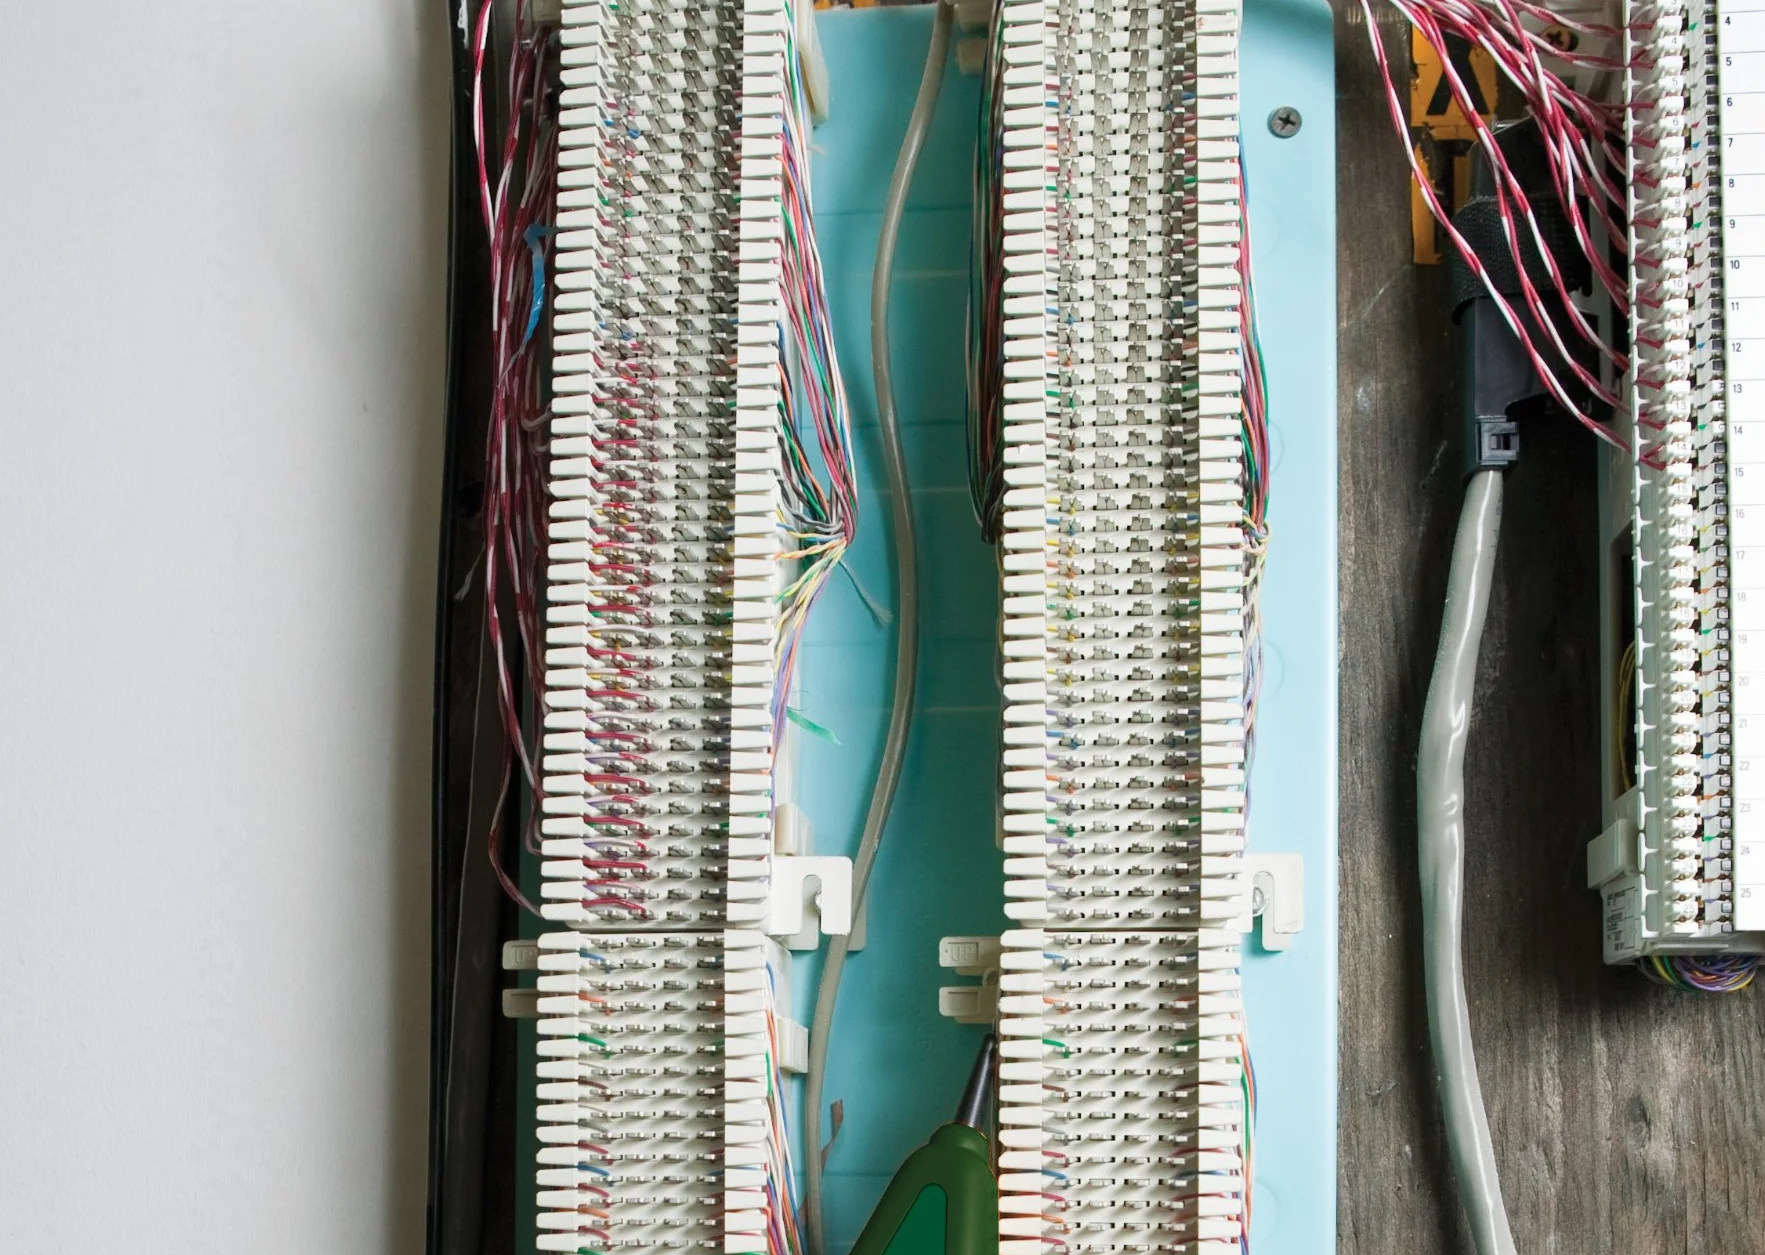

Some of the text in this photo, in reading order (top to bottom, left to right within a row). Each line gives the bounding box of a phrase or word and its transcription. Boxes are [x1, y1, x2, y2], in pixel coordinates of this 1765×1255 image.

[1725, 16, 1731, 25] 4
[1726, 57, 1731, 66] 5
[1727, 97, 1733, 106] 6
[1728, 138, 1733, 147] 7
[1729, 179, 1734, 188] 8
[1730, 219, 1735, 228] 9
[1730, 260, 1740, 269] 10
[1731, 302, 1739, 310] 11
[1732, 343, 1741, 352] 12
[1733, 384, 1742, 393] 13
[1734, 426, 1742, 434] 14
[1735, 467, 1744, 477] 15
[1735, 509, 1745, 518] 16
[1736, 551, 1745, 559] 17
[1737, 592, 1746, 601] 18
[1738, 635, 1747, 644] 19
[1738, 676, 1749, 687] 20
[1738, 719, 1747, 728] 21
[1739, 760, 1750, 771] 22
[1740, 803, 1750, 813] 23
[1740, 846, 1750, 855] 24
[1740, 888, 1751, 898] 25
